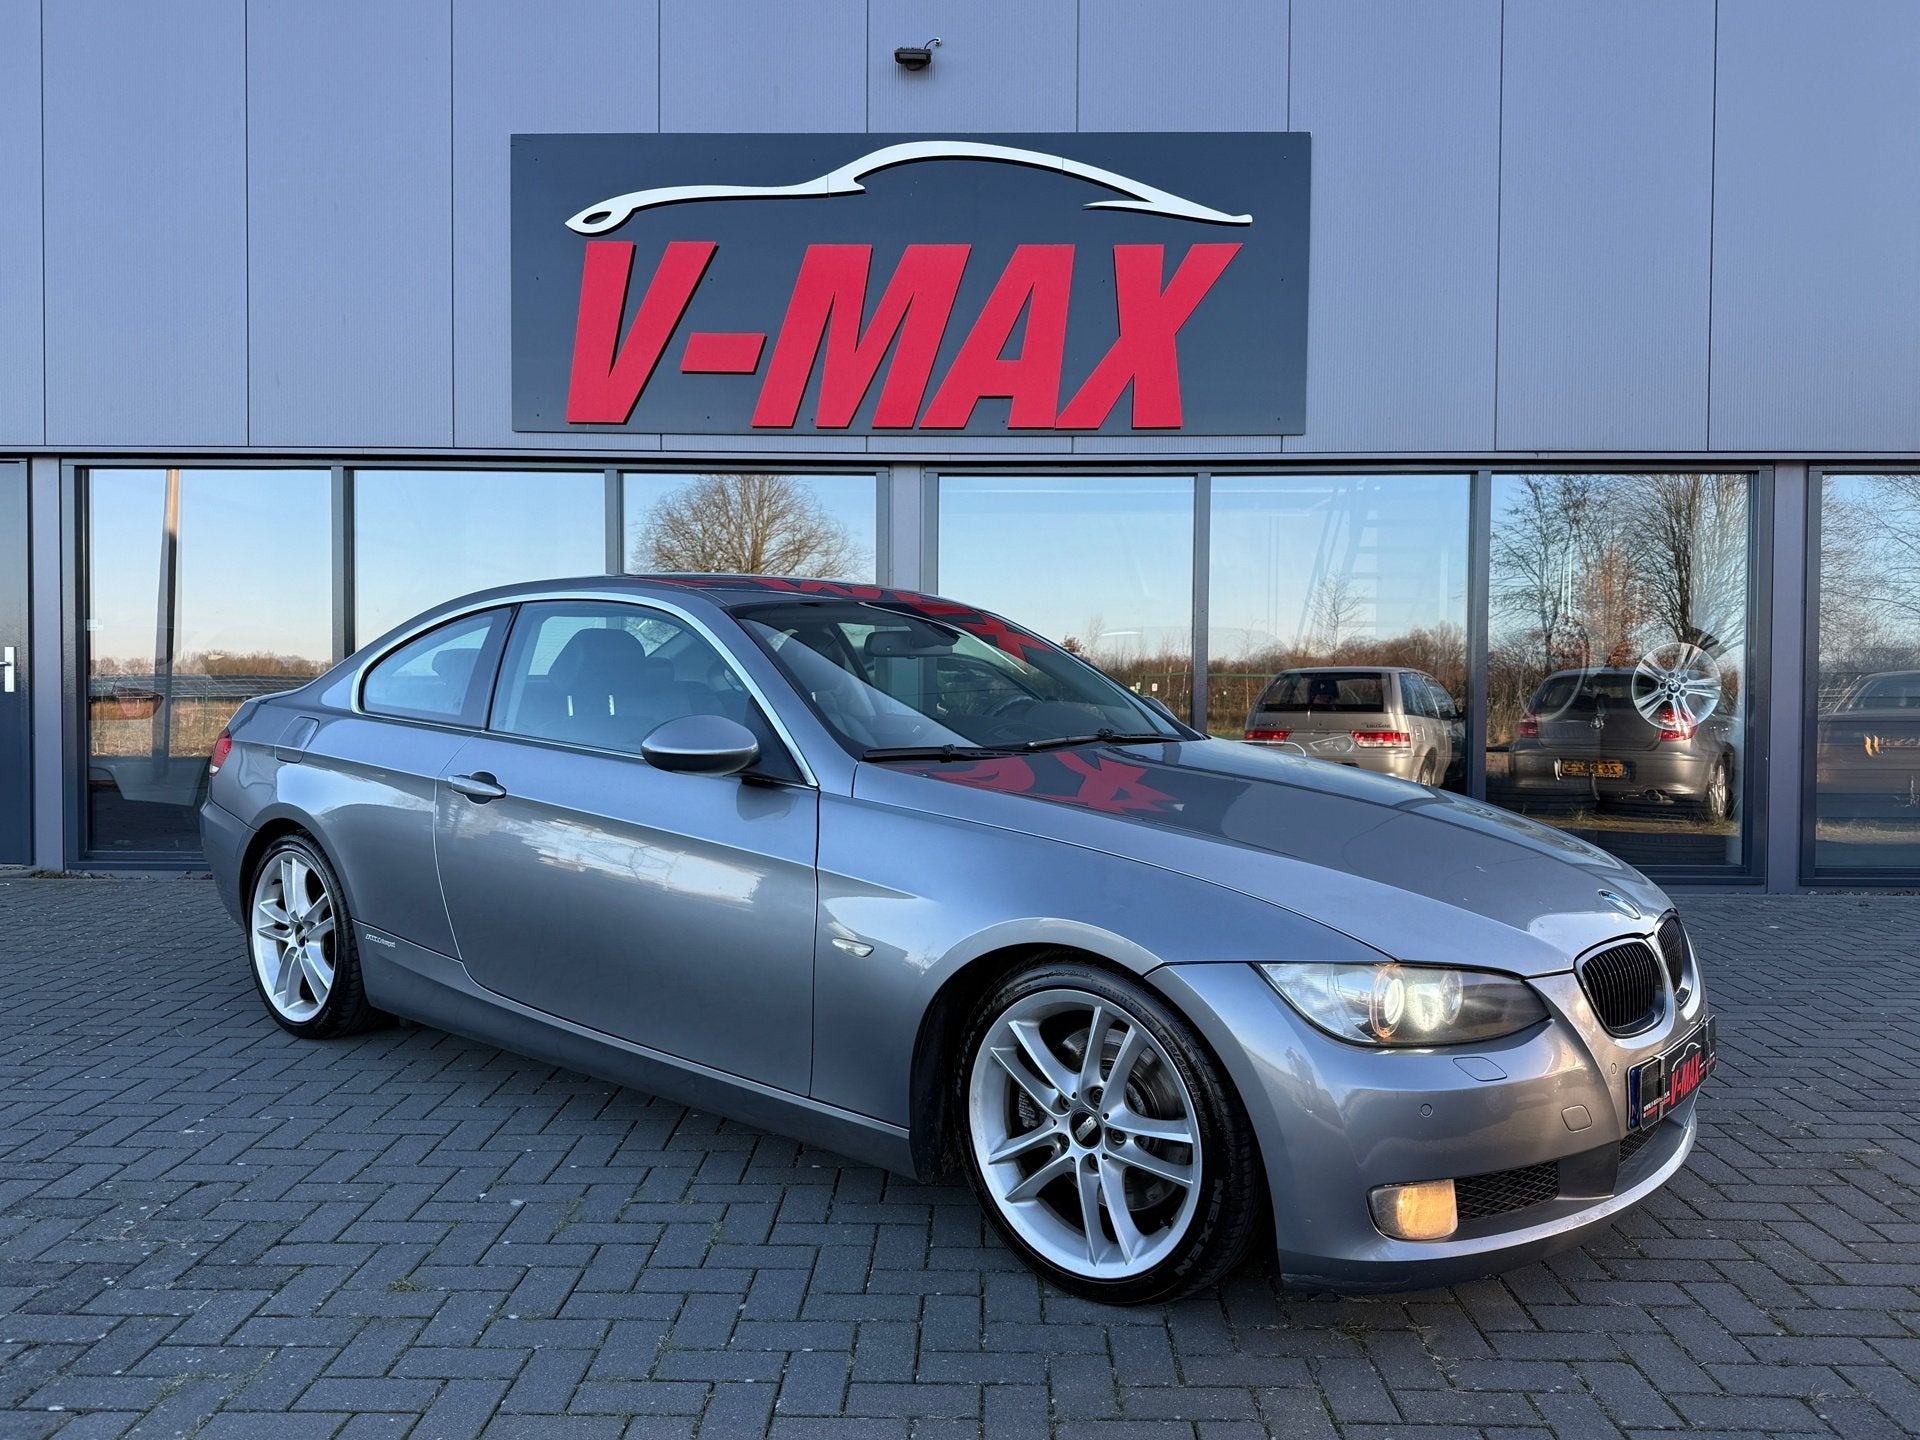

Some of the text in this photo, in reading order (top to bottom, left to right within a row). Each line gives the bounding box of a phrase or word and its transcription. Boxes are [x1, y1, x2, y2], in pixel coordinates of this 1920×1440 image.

[565, 240, 1244, 430] V-MAX
[1670, 1050, 1702, 1106] V-MAX
[1174, 1178, 1224, 1277] NEXEN
